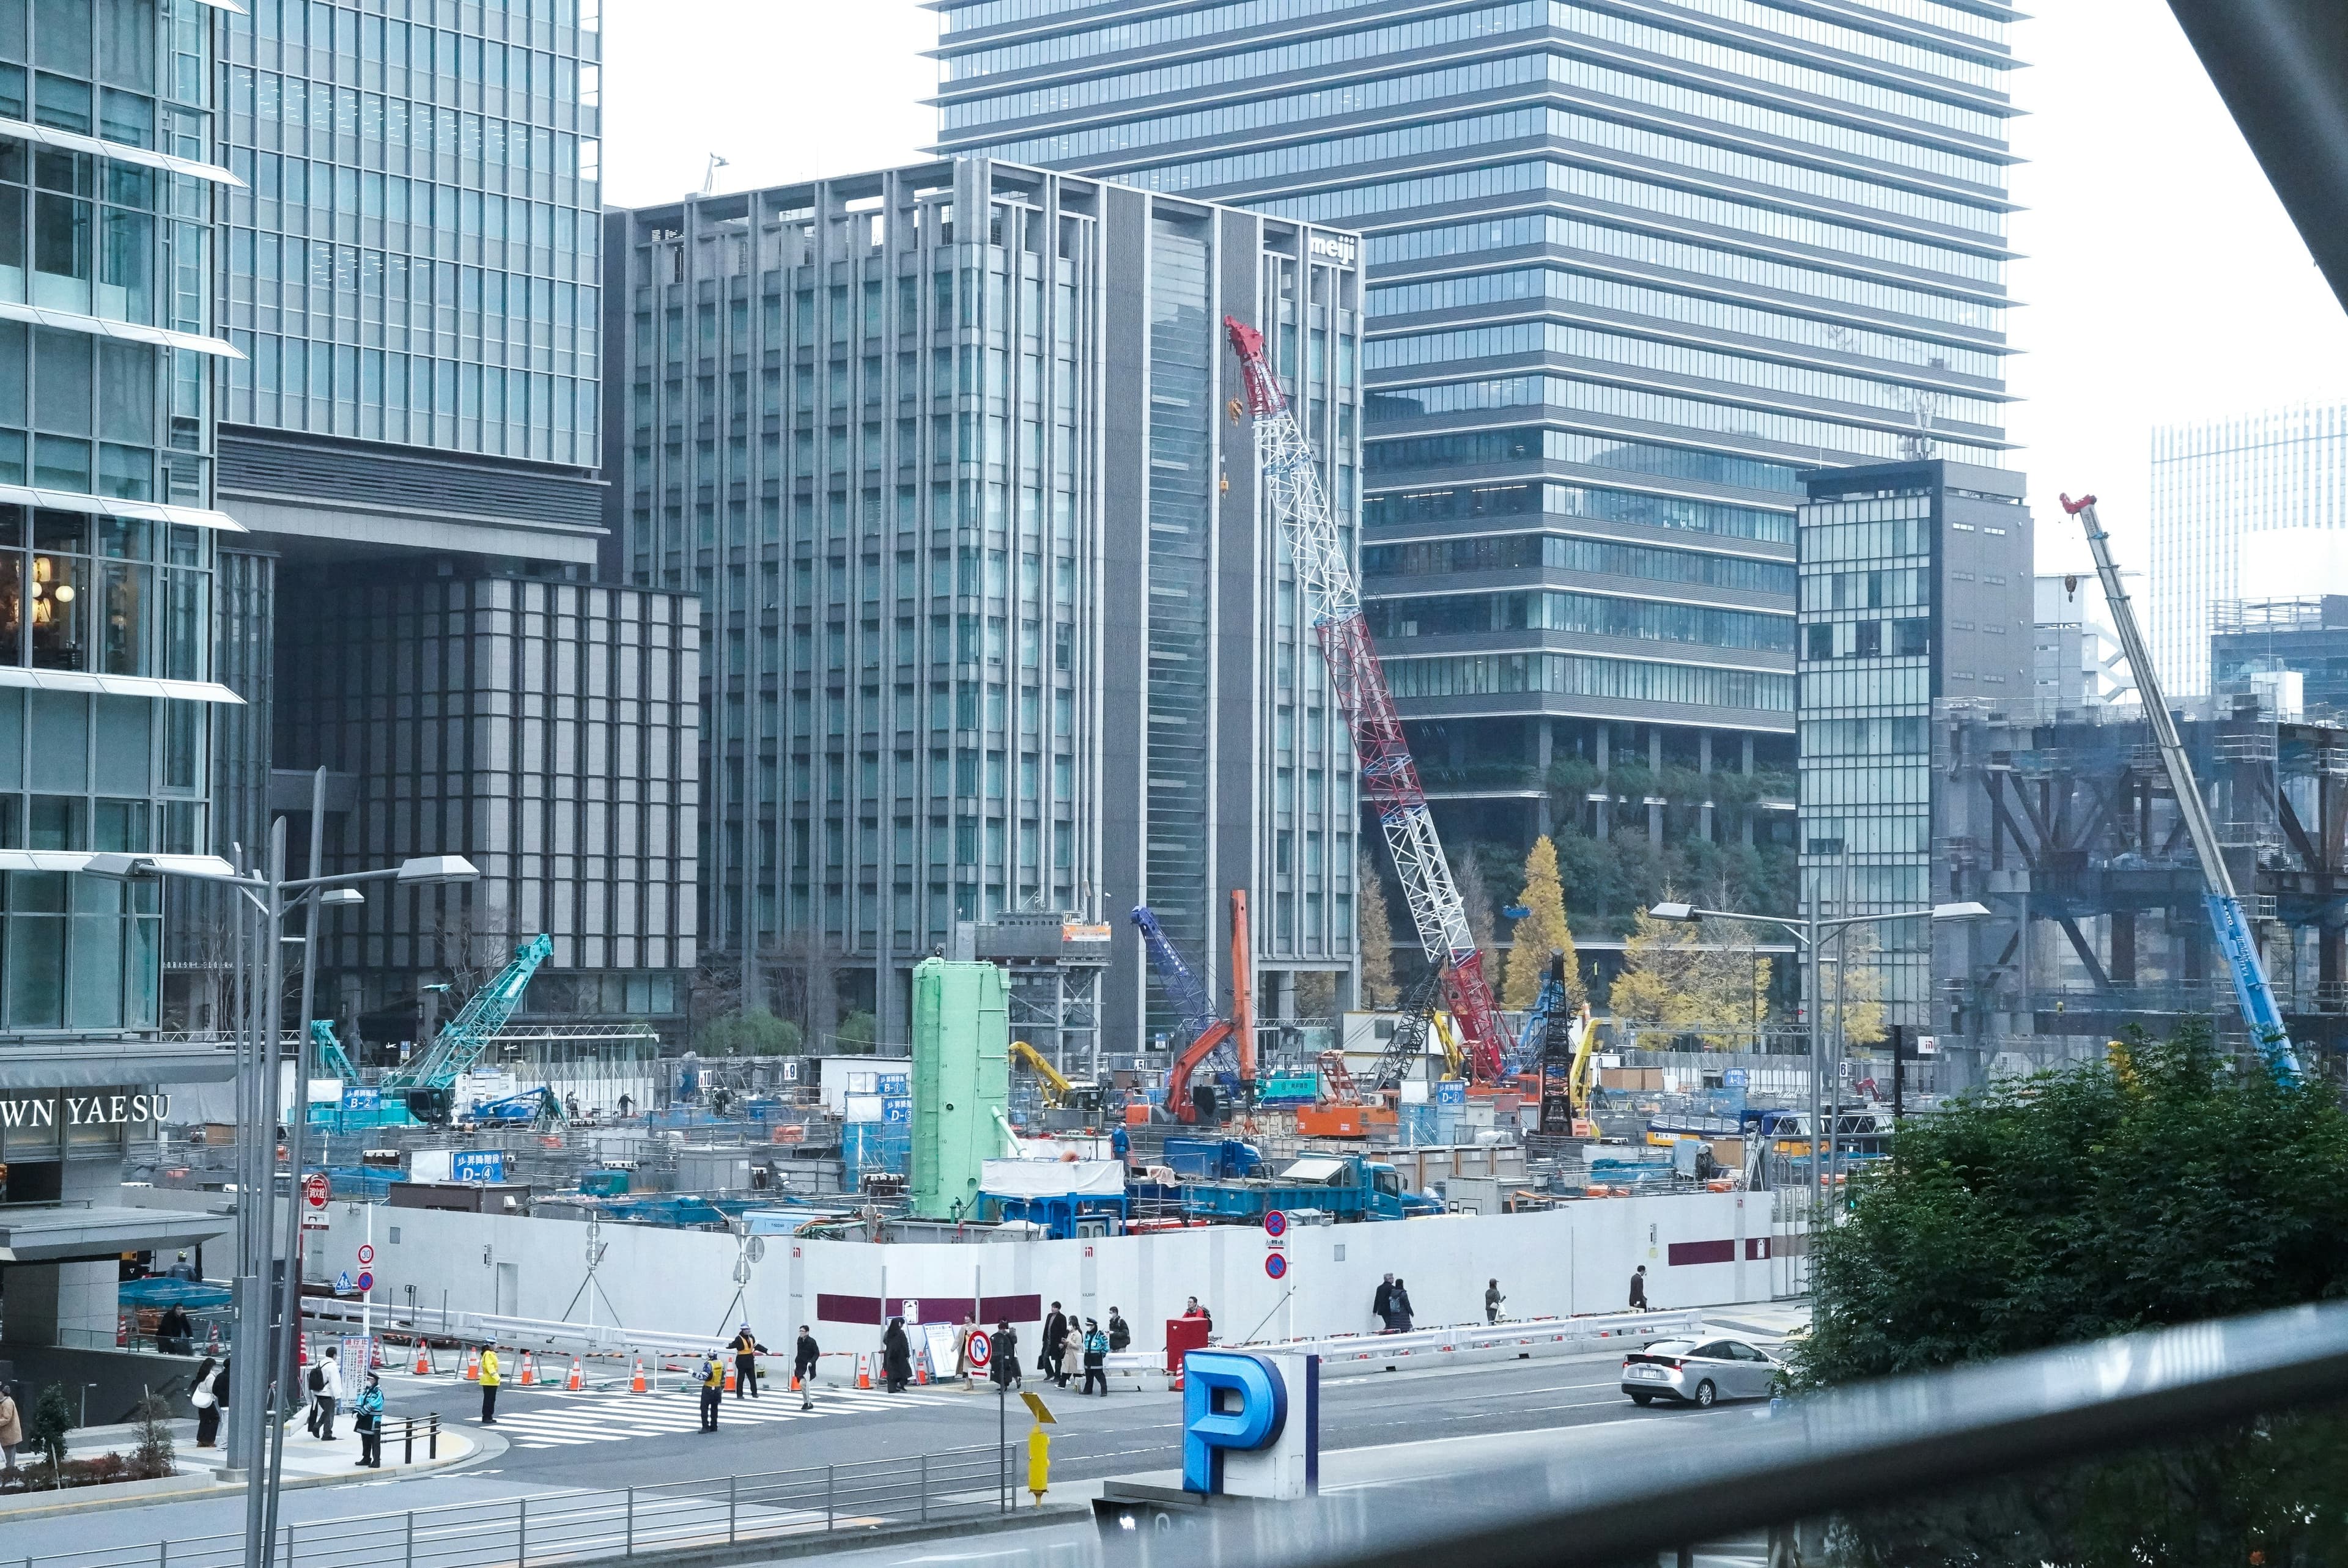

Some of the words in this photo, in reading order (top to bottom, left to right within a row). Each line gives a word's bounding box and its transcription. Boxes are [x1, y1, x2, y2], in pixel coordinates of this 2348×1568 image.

[1311, 235, 1355, 265] meiji
[1840, 1064, 1847, 1076] 6
[0, 1100, 55, 1127] WN
[65, 1094, 172, 1125] YAESU
[361, 1250, 371, 1259] 30
[1183, 1350, 1288, 1494] P
